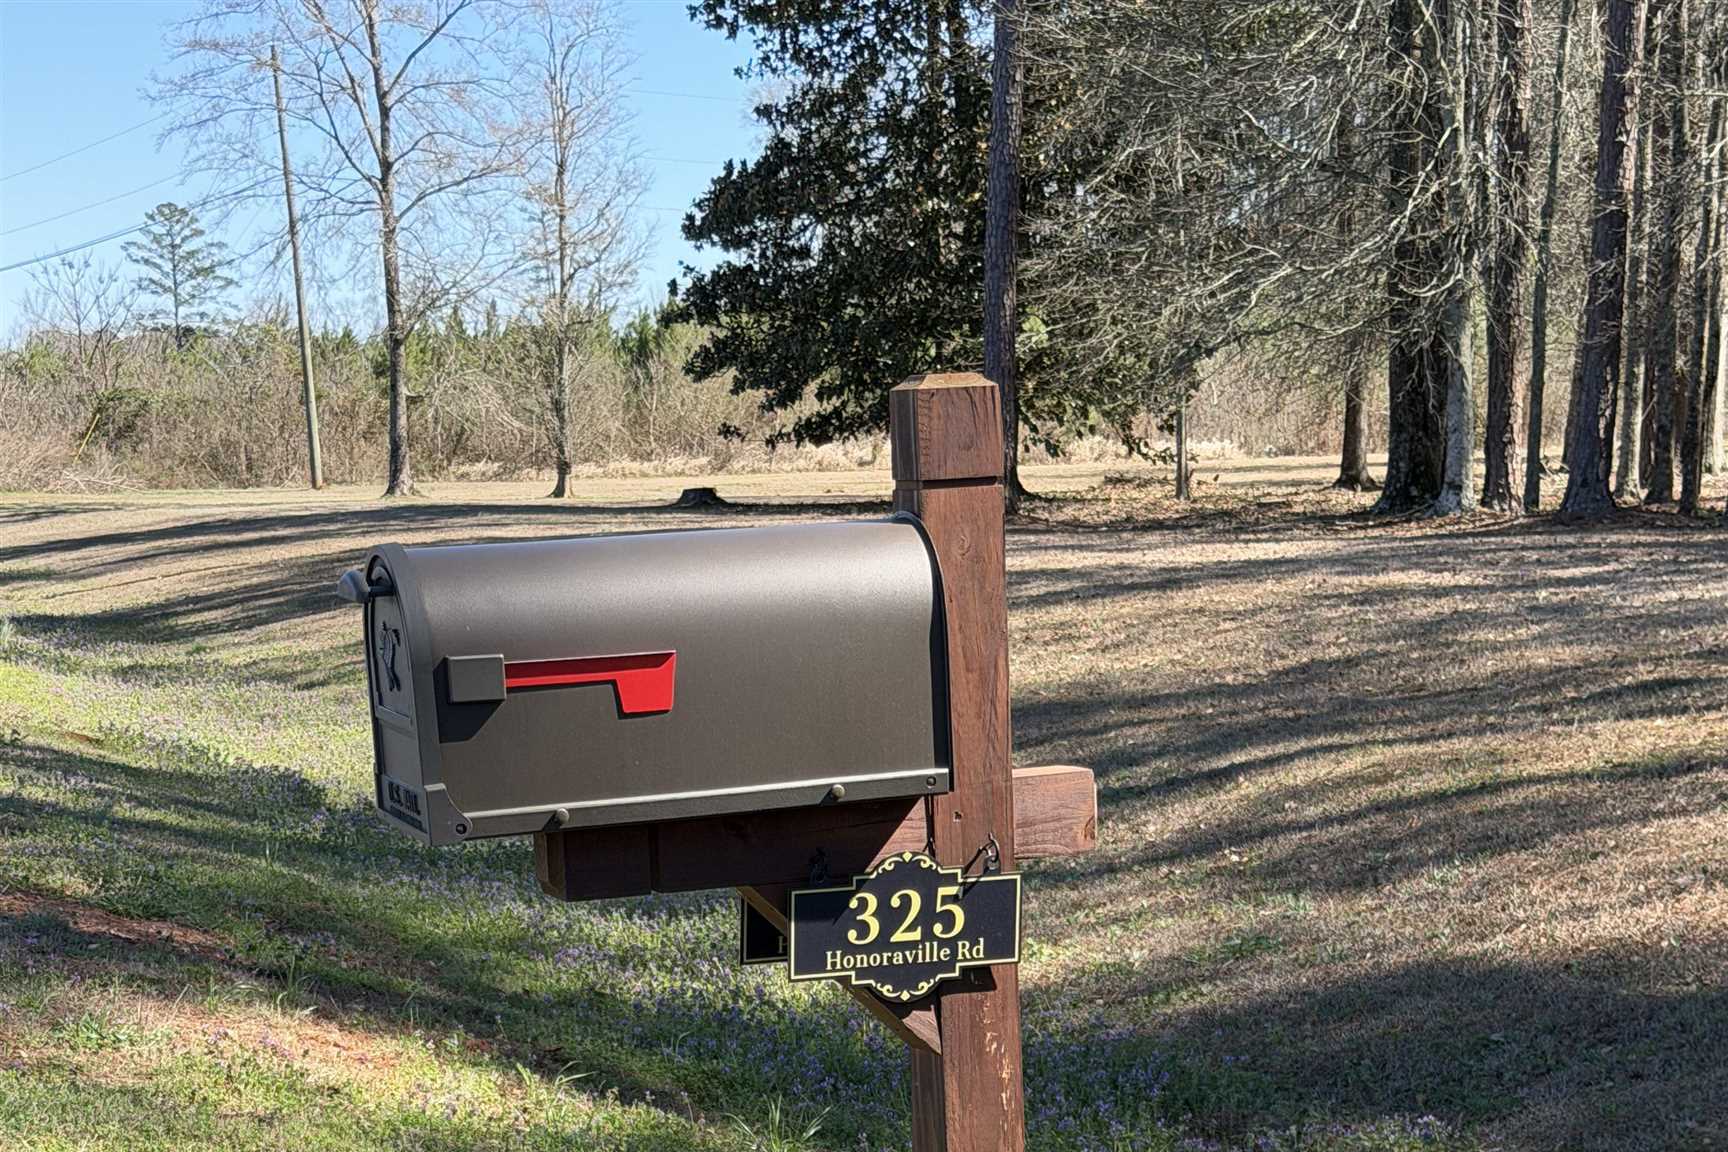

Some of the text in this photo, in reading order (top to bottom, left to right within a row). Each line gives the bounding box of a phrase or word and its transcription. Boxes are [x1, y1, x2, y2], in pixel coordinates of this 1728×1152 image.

[847, 886, 966, 945] 325
[825, 937, 985, 971] Honoraville Rd
